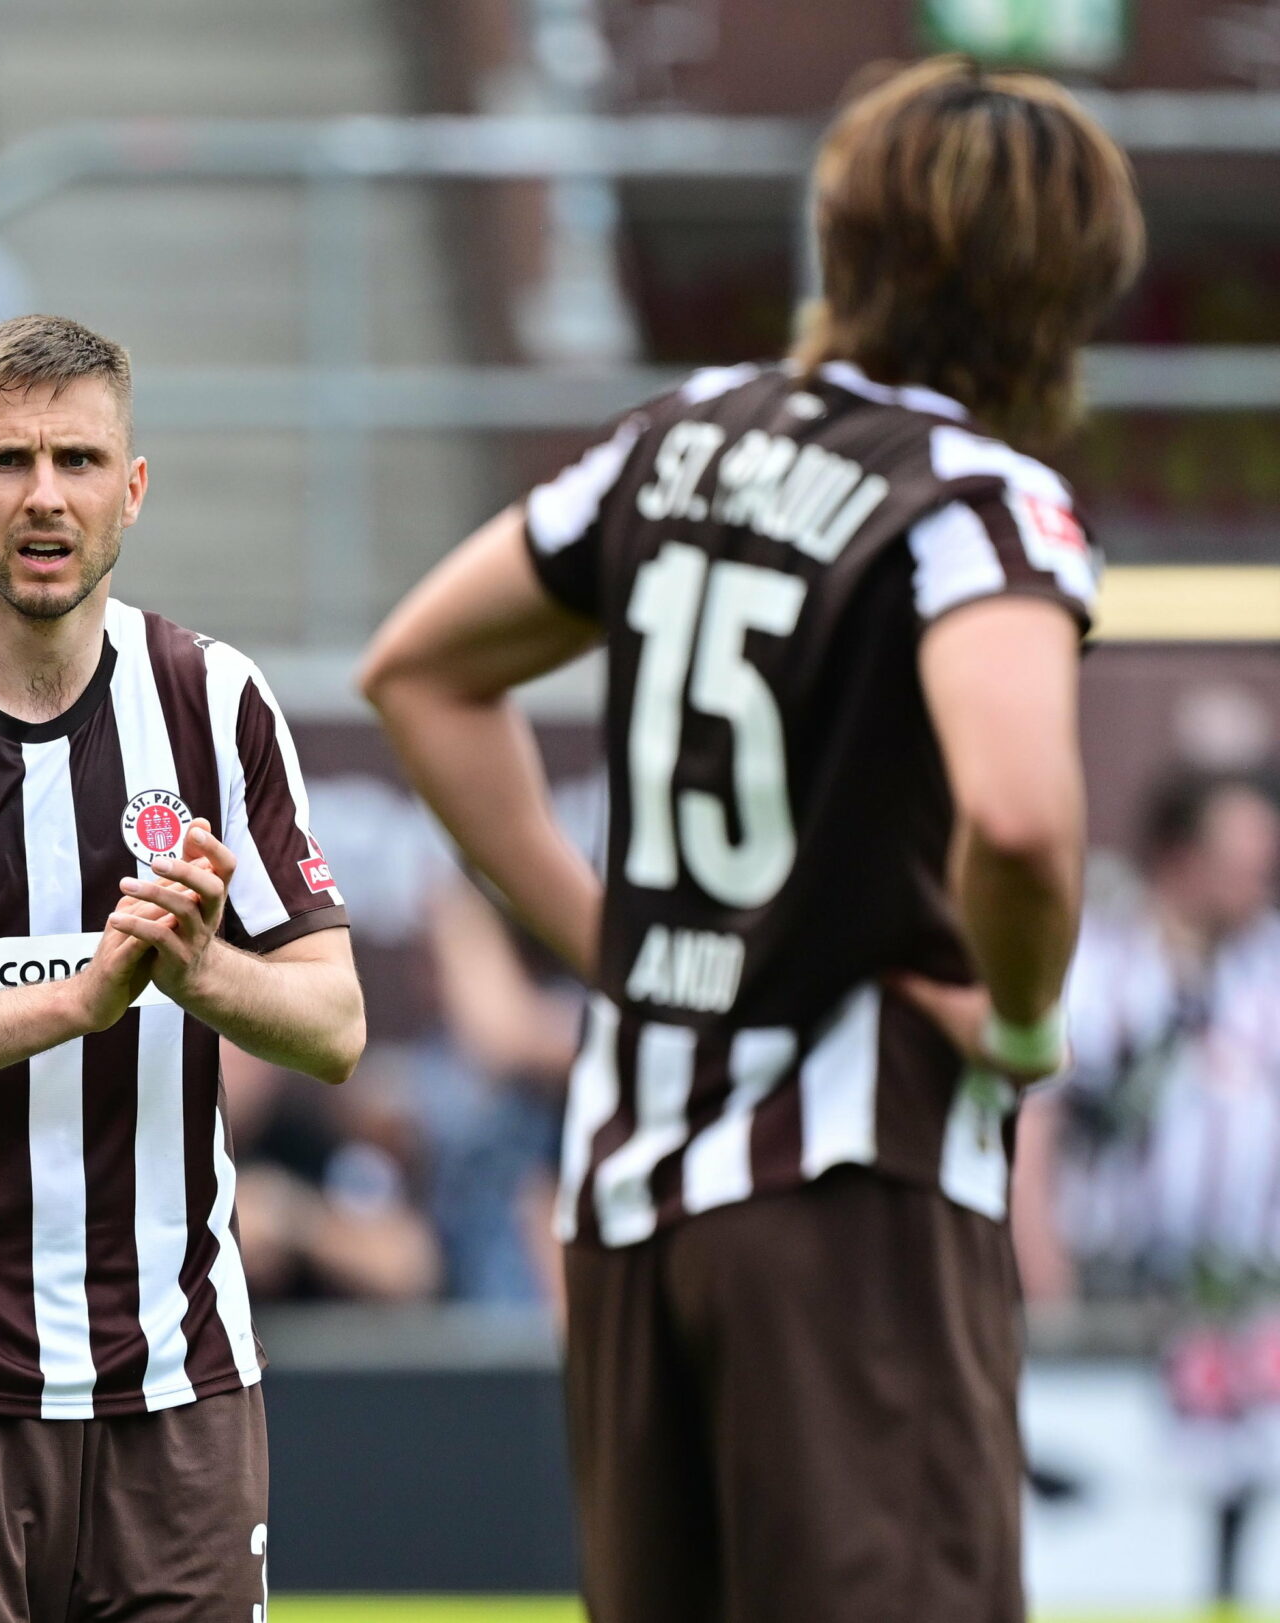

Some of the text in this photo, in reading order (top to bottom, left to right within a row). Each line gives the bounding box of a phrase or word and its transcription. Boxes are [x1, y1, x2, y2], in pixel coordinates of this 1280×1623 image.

[124, 793, 191, 829] FC ST. PAULI
[627, 542, 808, 909] 15
